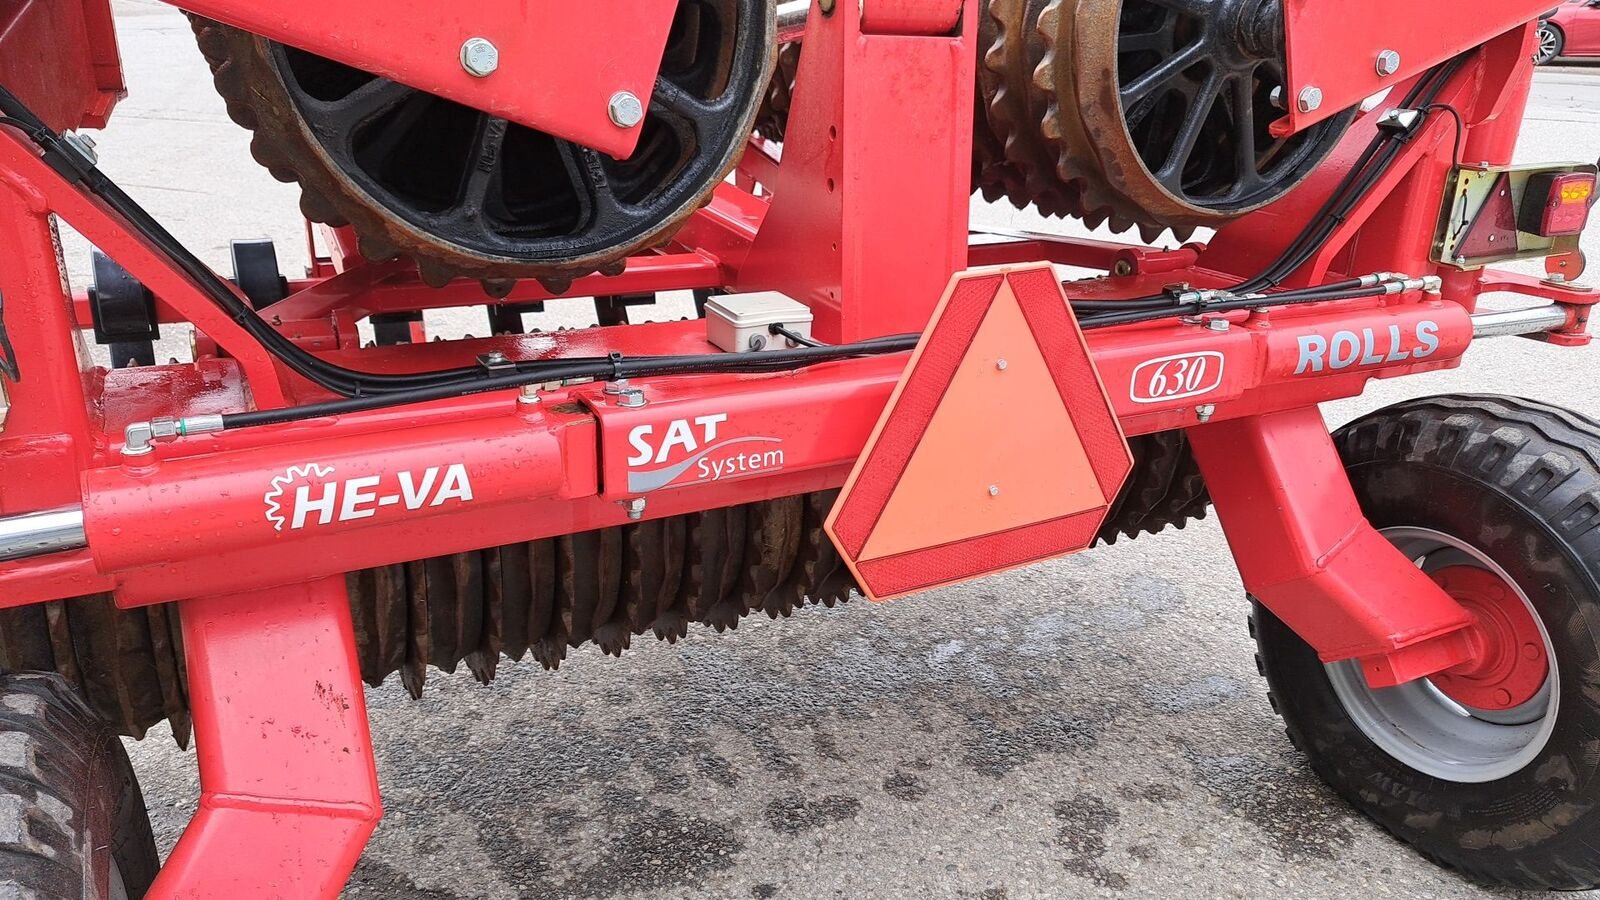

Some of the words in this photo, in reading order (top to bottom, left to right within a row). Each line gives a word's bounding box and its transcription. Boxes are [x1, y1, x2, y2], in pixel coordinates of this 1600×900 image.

[1294, 320, 1440, 375] ROLLS
[1148, 356, 1206, 398] 630
[627, 412, 728, 467] SAT
[697, 448, 785, 481] System
[291, 462, 474, 530] HE-VA
